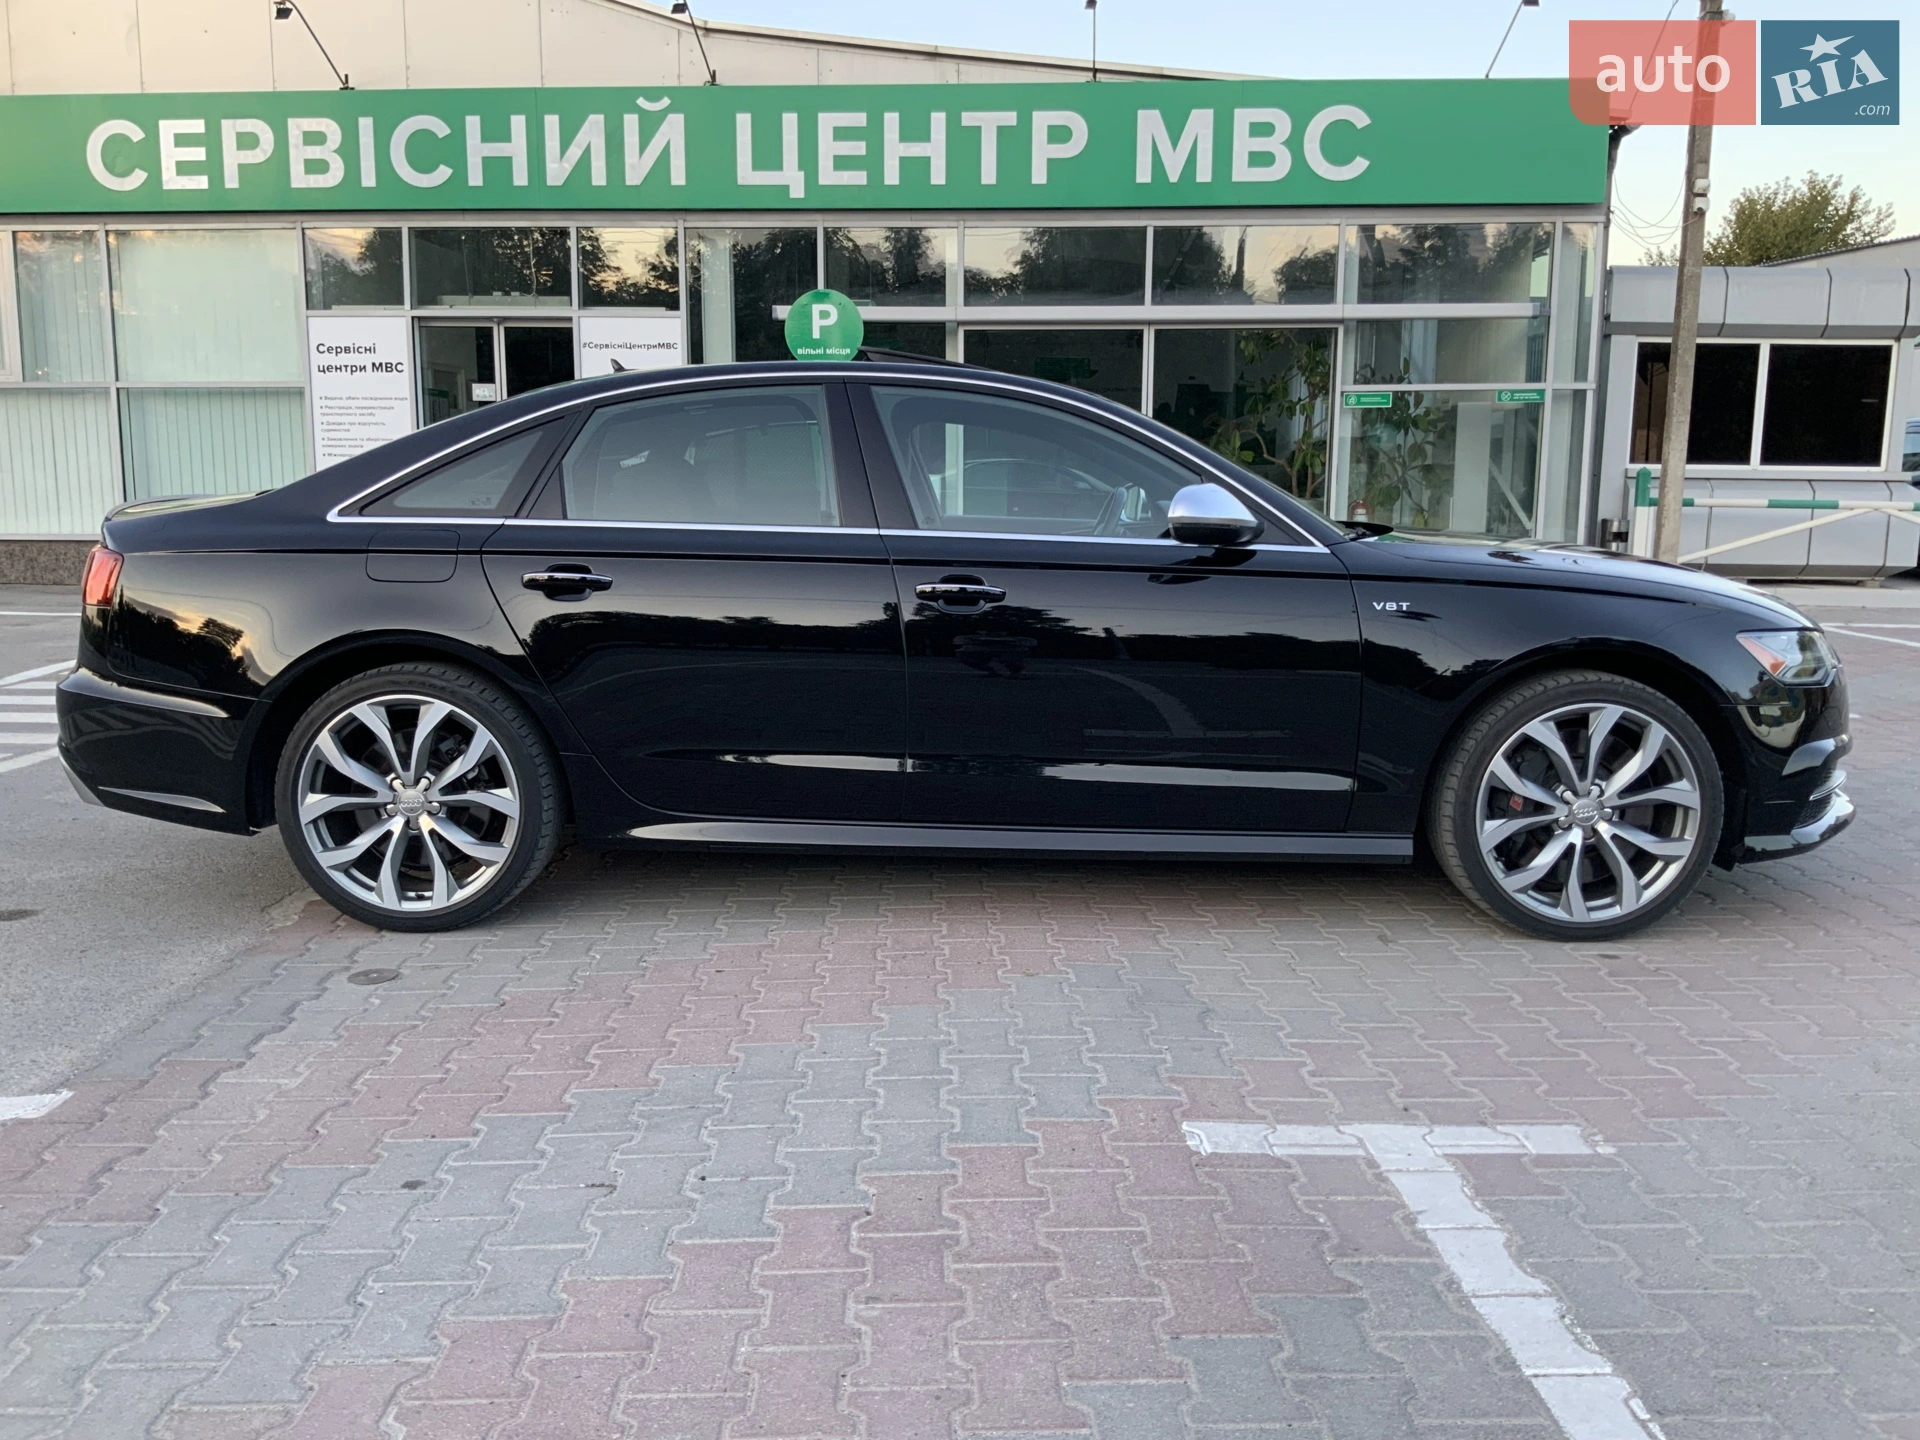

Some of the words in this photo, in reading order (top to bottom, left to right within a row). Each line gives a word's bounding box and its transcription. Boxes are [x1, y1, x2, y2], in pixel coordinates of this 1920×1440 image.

[85, 95, 687, 192] СЕРВІСНИЙ
[735, 110, 1089, 199] ЦЕНТР
[1135, 104, 1372, 184] МВС
[811, 303, 839, 339] P
[316, 342, 376, 357] Сервісні
[582, 341, 678, 351] #СервісніЦентриМВС
[797, 346, 824, 355] вільні
[826, 346, 851, 356] місця
[317, 364, 367, 375] центри
[371, 362, 405, 373] МВС
[1372, 601, 1411, 611] V8T
